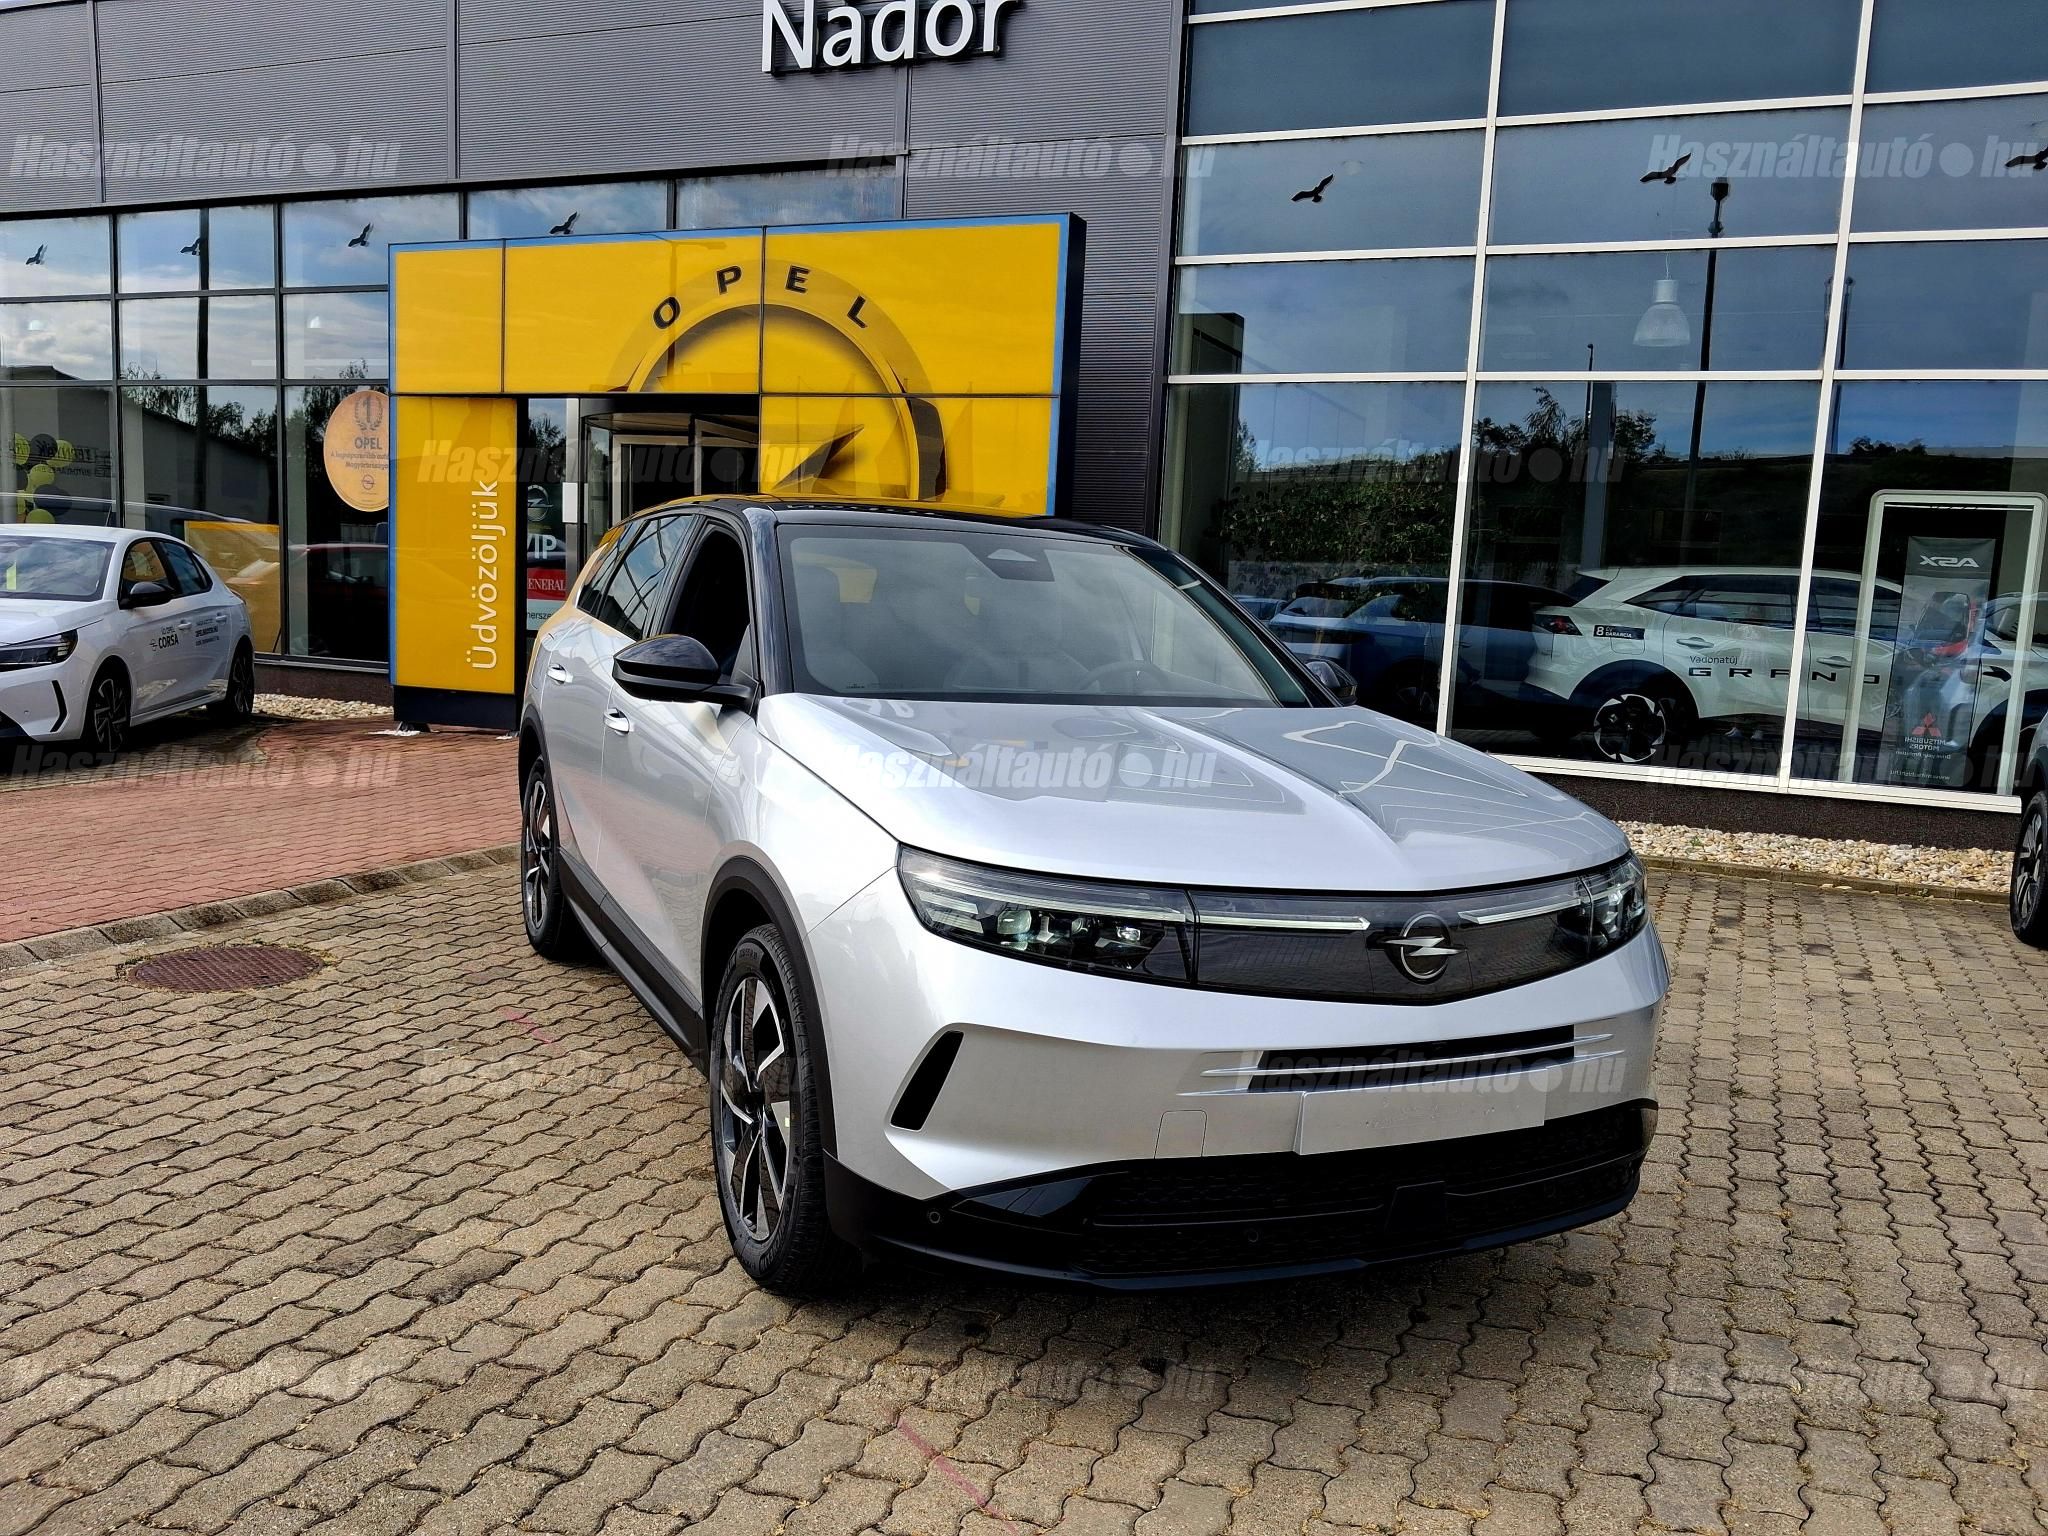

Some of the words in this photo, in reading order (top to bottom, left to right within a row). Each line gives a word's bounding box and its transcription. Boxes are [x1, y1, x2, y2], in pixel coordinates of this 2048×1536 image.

[653, 265, 868, 329] OPEL
[354, 437, 383, 450] OPEL
[467, 481, 506, 668] Üdvözöljük
[1596, 627, 1604, 636] 8
[159, 634, 179, 648] CORSA
